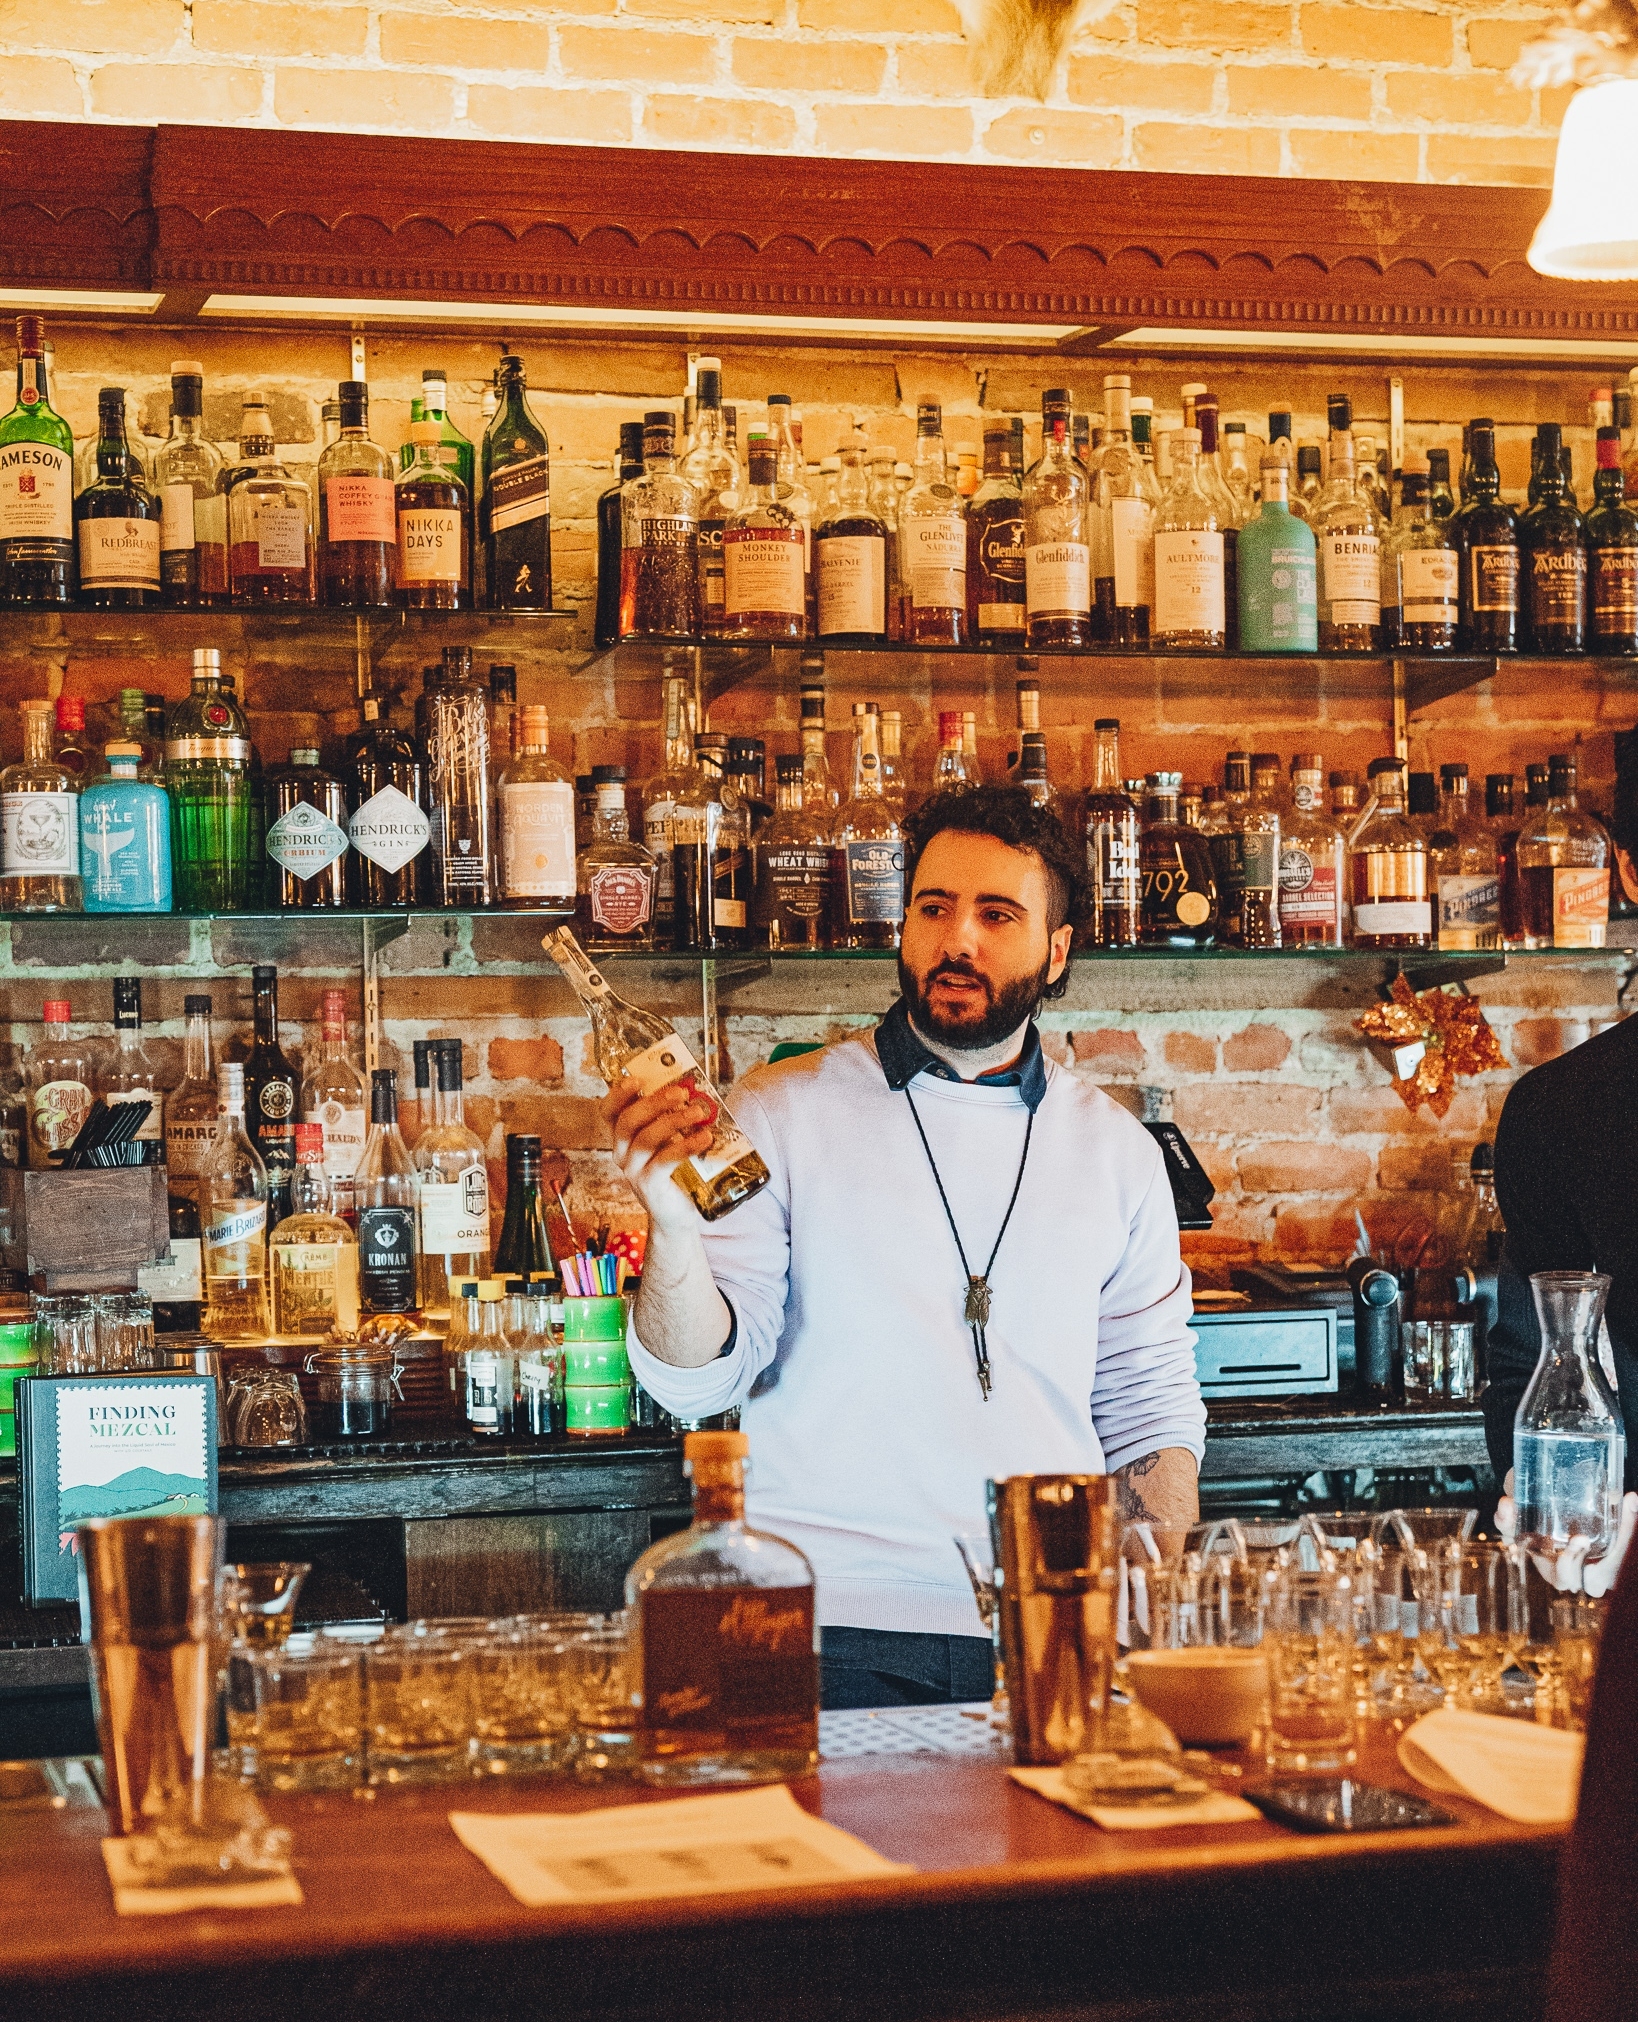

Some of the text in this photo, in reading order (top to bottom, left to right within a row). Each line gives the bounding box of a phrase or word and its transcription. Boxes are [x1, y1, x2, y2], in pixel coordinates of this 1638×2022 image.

[0, 450, 62, 471] AMESON
[493, 469, 548, 492] DOUBLE BLACK
[406, 518, 454, 532] NIKKA
[406, 535, 443, 548] DAYS
[642, 530, 676, 542] PARK
[699, 530, 722, 546] SC
[920, 531, 964, 544] GLENLIVET
[742, 544, 787, 552] MONKEY
[988, 542, 1026, 558] Glenfid
[738, 553, 790, 562] SHOULDER
[1036, 547, 1085, 564] Glenfiddich
[1166, 554, 1220, 564] AULTMORE
[1190, 586, 1201, 594] 12
[516, 803, 564, 814] NORDEN
[84, 812, 133, 824] WHALE
[514, 814, 565, 827] AQUAVIT
[350, 824, 428, 837] HENDRICK'S
[270, 834, 343, 848] HENDRICK'S
[379, 840, 404, 848] GIN
[282, 849, 326, 857] ORBIUM
[868, 850, 889, 861] OLD
[768, 856, 803, 868] WHEAT
[166, 1127, 218, 1140] AMARG
[235, 1210, 266, 1238] BRIZARD
[209, 1224, 234, 1243] MARIE
[368, 1252, 406, 1266] KRONAN
[89, 1405, 176, 1420] FINDING
[90, 1422, 176, 1438] MEZCAL
